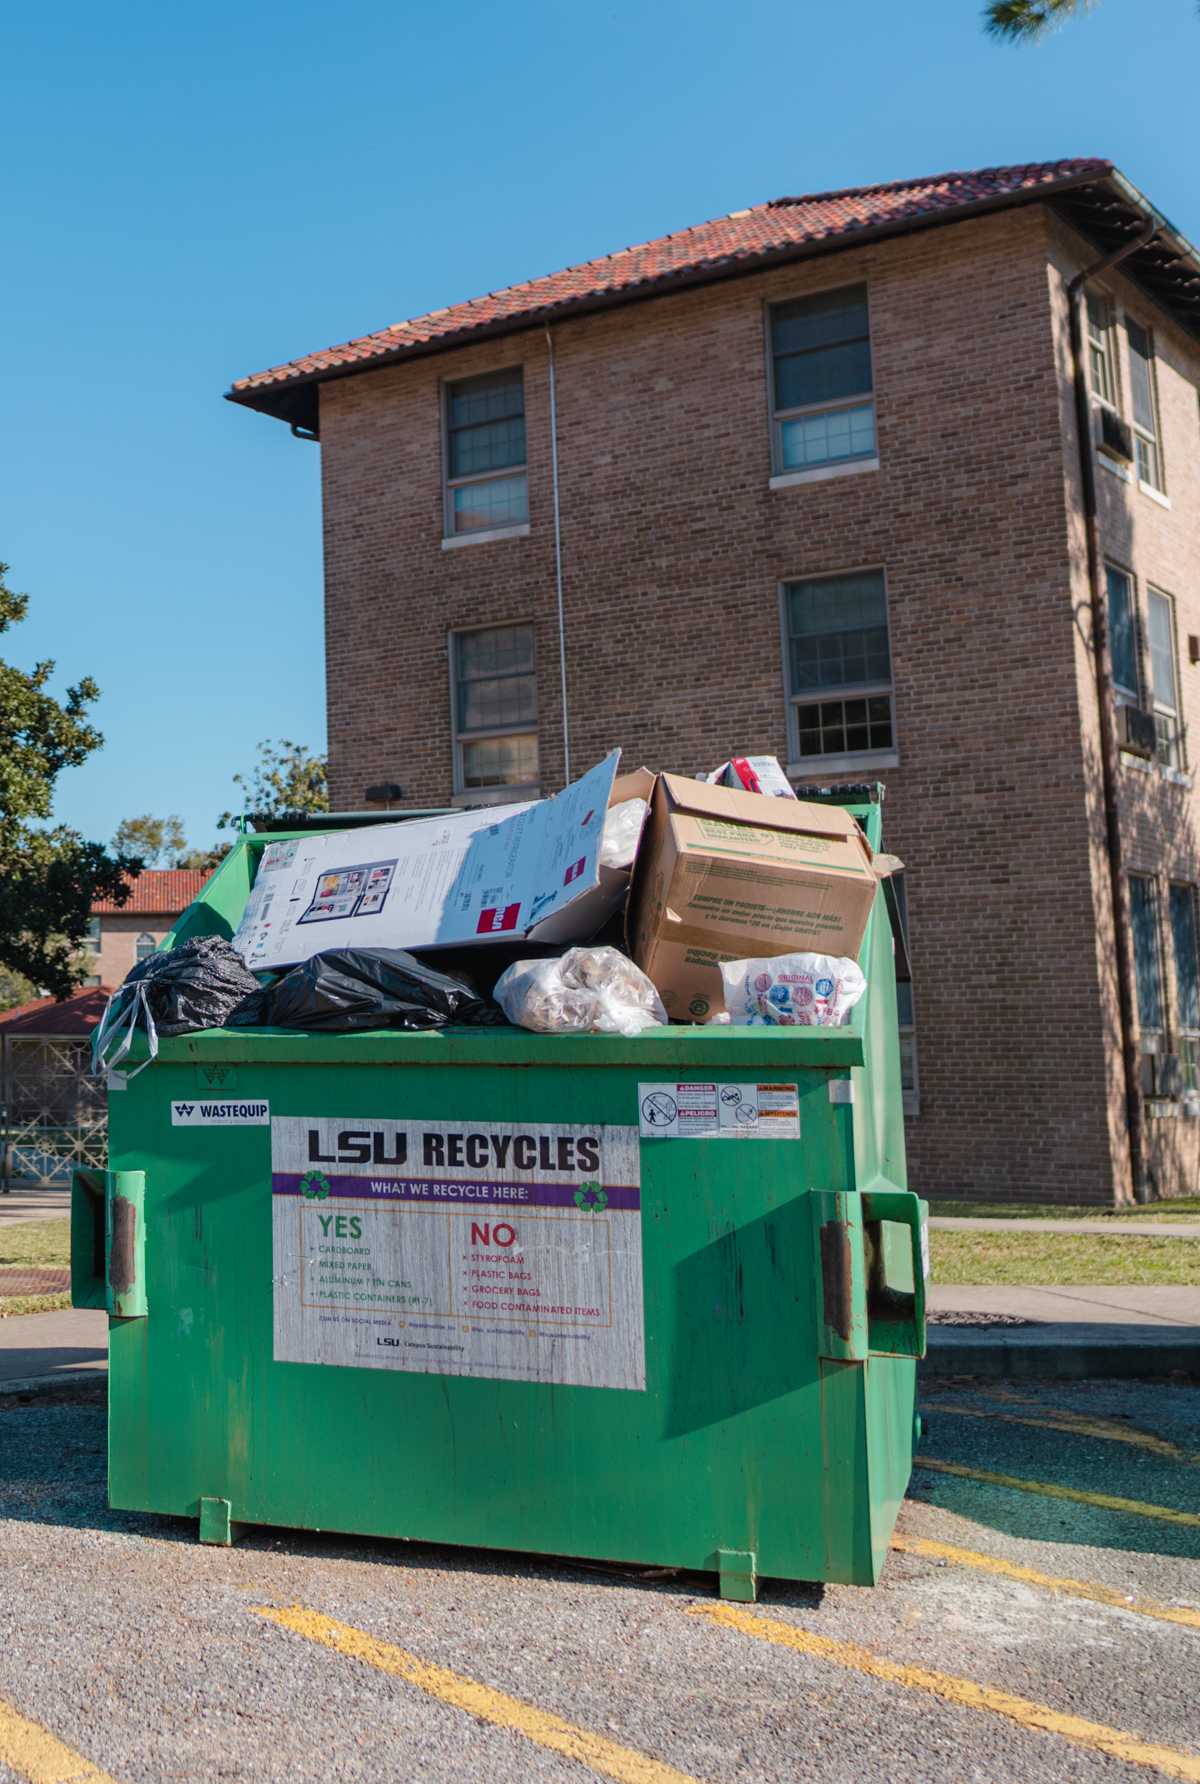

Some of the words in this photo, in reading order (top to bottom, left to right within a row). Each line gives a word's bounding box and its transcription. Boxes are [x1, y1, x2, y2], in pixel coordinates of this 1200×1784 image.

[200, 1104, 268, 1118] WASTEQUIP
[308, 1129, 407, 1165] LSU
[423, 1132, 600, 1172] RECYCLES
[371, 1181, 406, 1195] WHAT
[410, 1184, 429, 1195] WE
[433, 1184, 489, 1198] RECYCLE
[492, 1186, 529, 1200] HERE:
[318, 1215, 362, 1239] YES
[471, 1222, 516, 1248] NO
[318, 1245, 371, 1256] CARDBOARD
[319, 1261, 345, 1270] MIXED
[347, 1262, 372, 1271] PAPER
[471, 1254, 525, 1265] STYROFOAM
[319, 1275, 364, 1286] ALUMINUM
[388, 1280, 412, 1289] CANS
[471, 1269, 506, 1279] PLASTIC
[508, 1271, 532, 1281] BAGS
[319, 1290, 351, 1300] PLASTIC
[353, 1292, 406, 1304] CONTAINERS
[471, 1285, 514, 1295] GROCERY
[517, 1287, 541, 1297] BAGS
[471, 1300, 498, 1311] FOOD
[500, 1302, 573, 1315] CONTAMINATED
[574, 1306, 601, 1317] ITEMS
[377, 1337, 400, 1347] LSU
